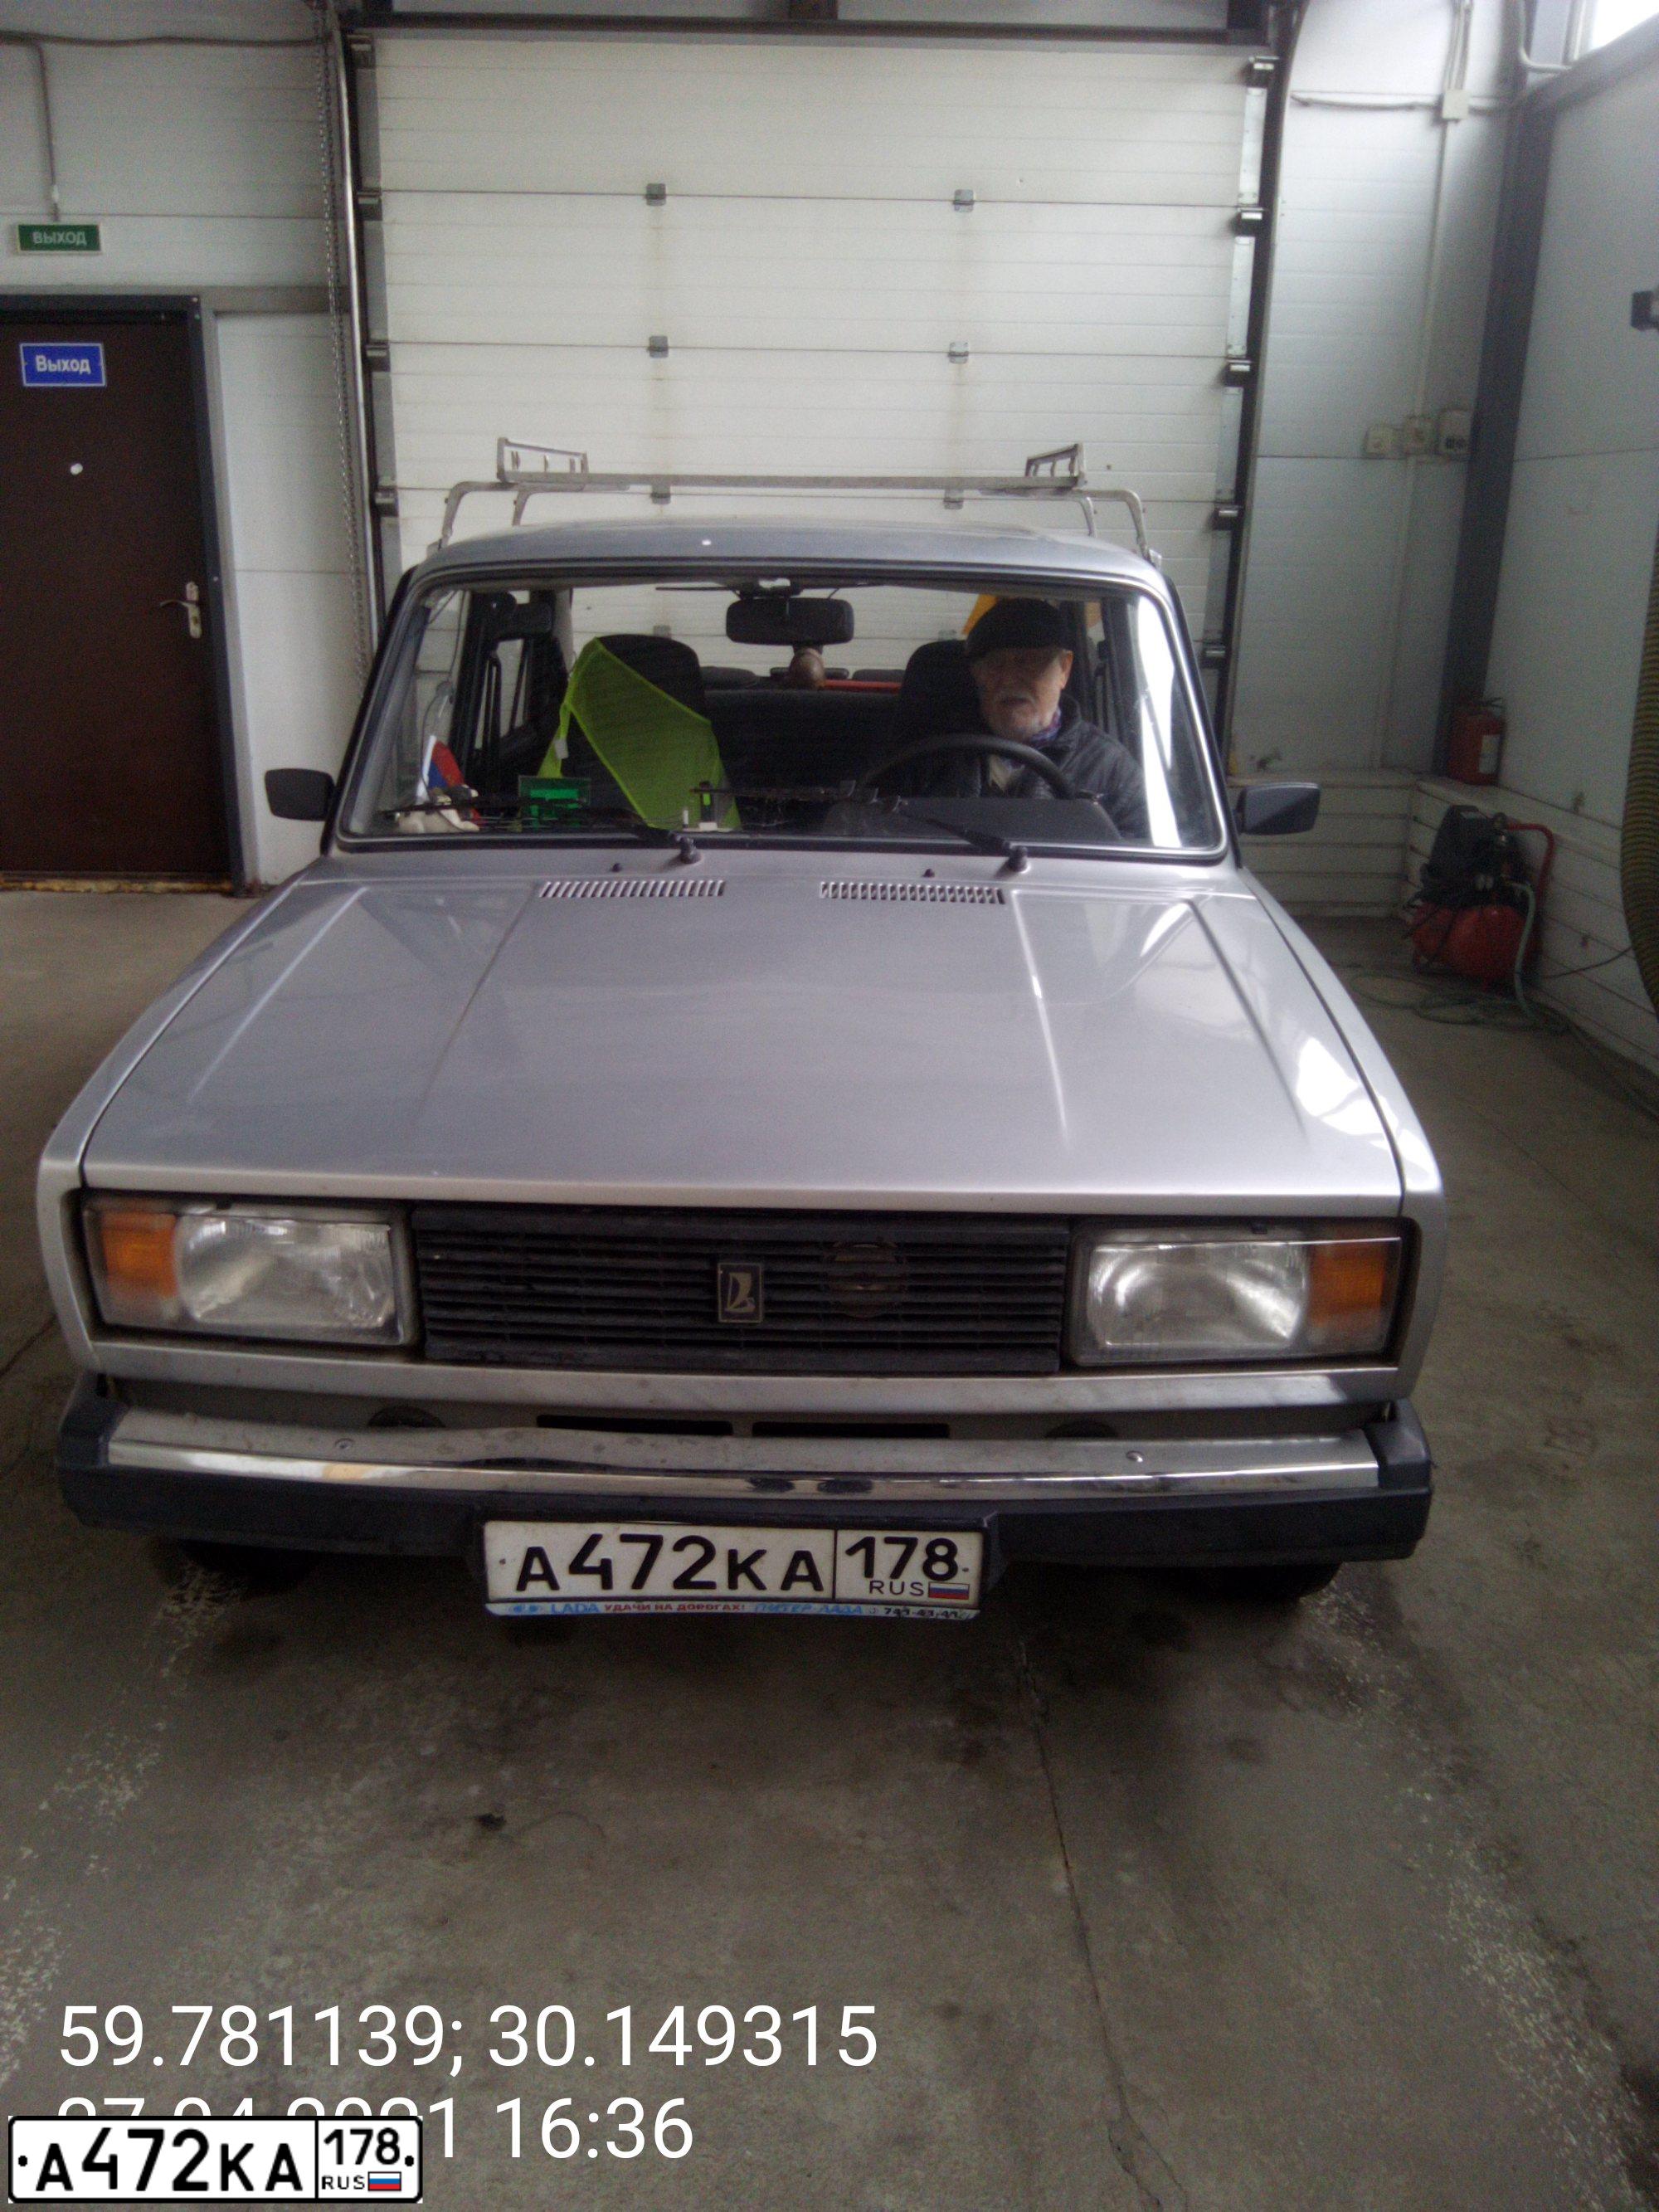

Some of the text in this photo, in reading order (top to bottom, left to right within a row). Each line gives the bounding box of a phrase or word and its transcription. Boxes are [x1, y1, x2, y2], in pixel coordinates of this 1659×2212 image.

[32, 231, 87, 246] ВЫХОД
[36, 355, 91, 375] Выход
[845, 1537, 959, 1581] 178
[869, 1581, 925, 1597] RUS
[551, 1603, 600, 1615] LADA
